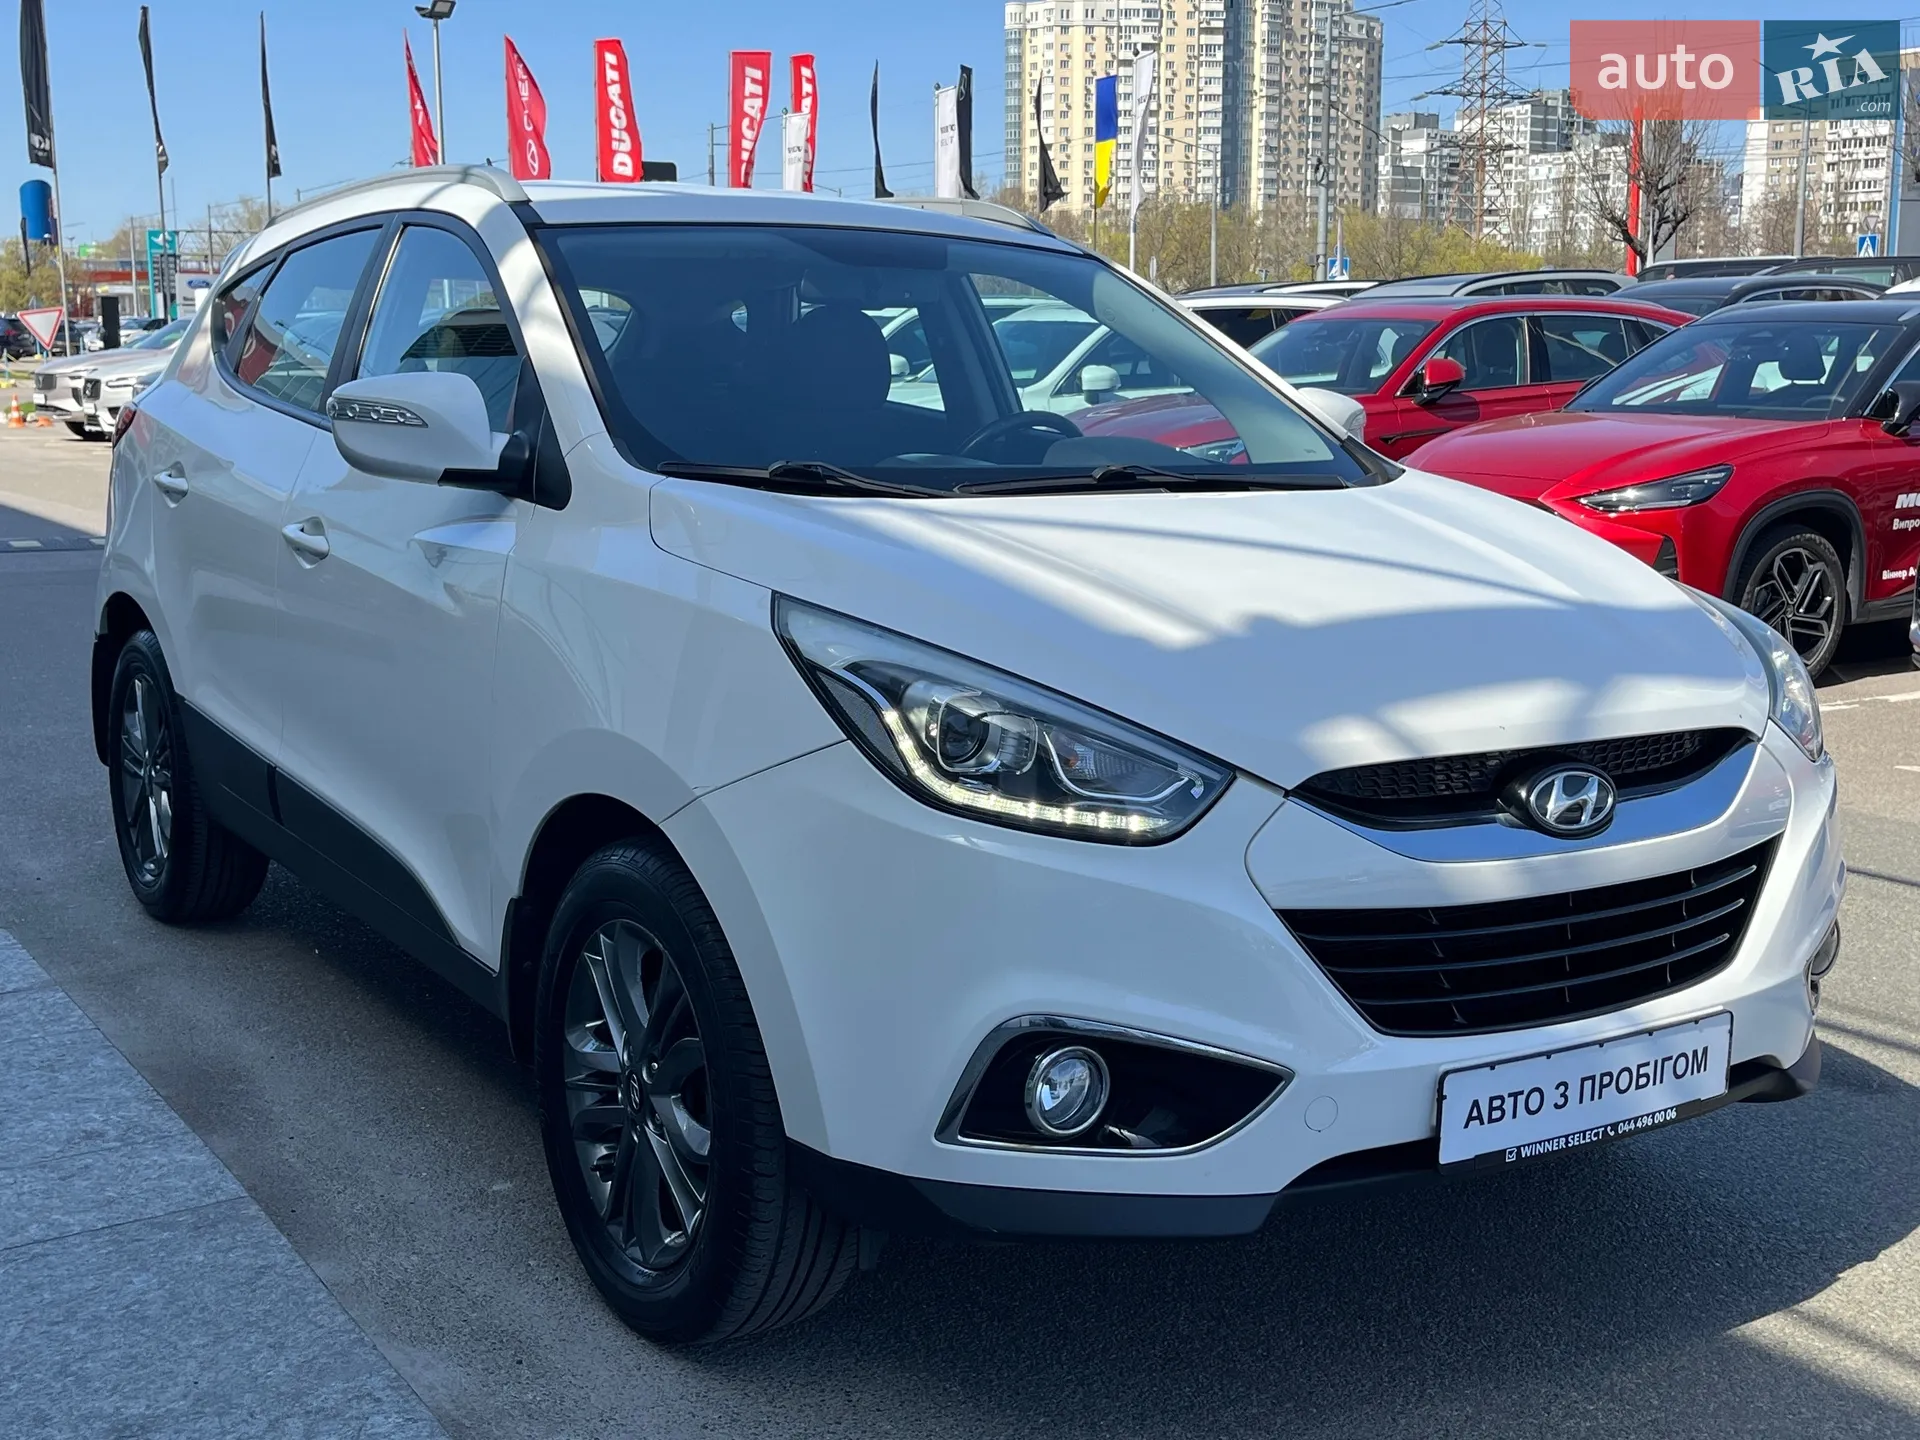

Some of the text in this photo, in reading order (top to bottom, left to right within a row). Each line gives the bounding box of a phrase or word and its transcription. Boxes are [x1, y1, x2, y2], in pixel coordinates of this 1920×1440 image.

[604, 51, 634, 177] DUCATI
[1463, 1046, 1709, 1129] АВТО З ПРОБІГОМ
[1520, 1108, 1677, 1158] WINNER SELECT 044 496 00 06
